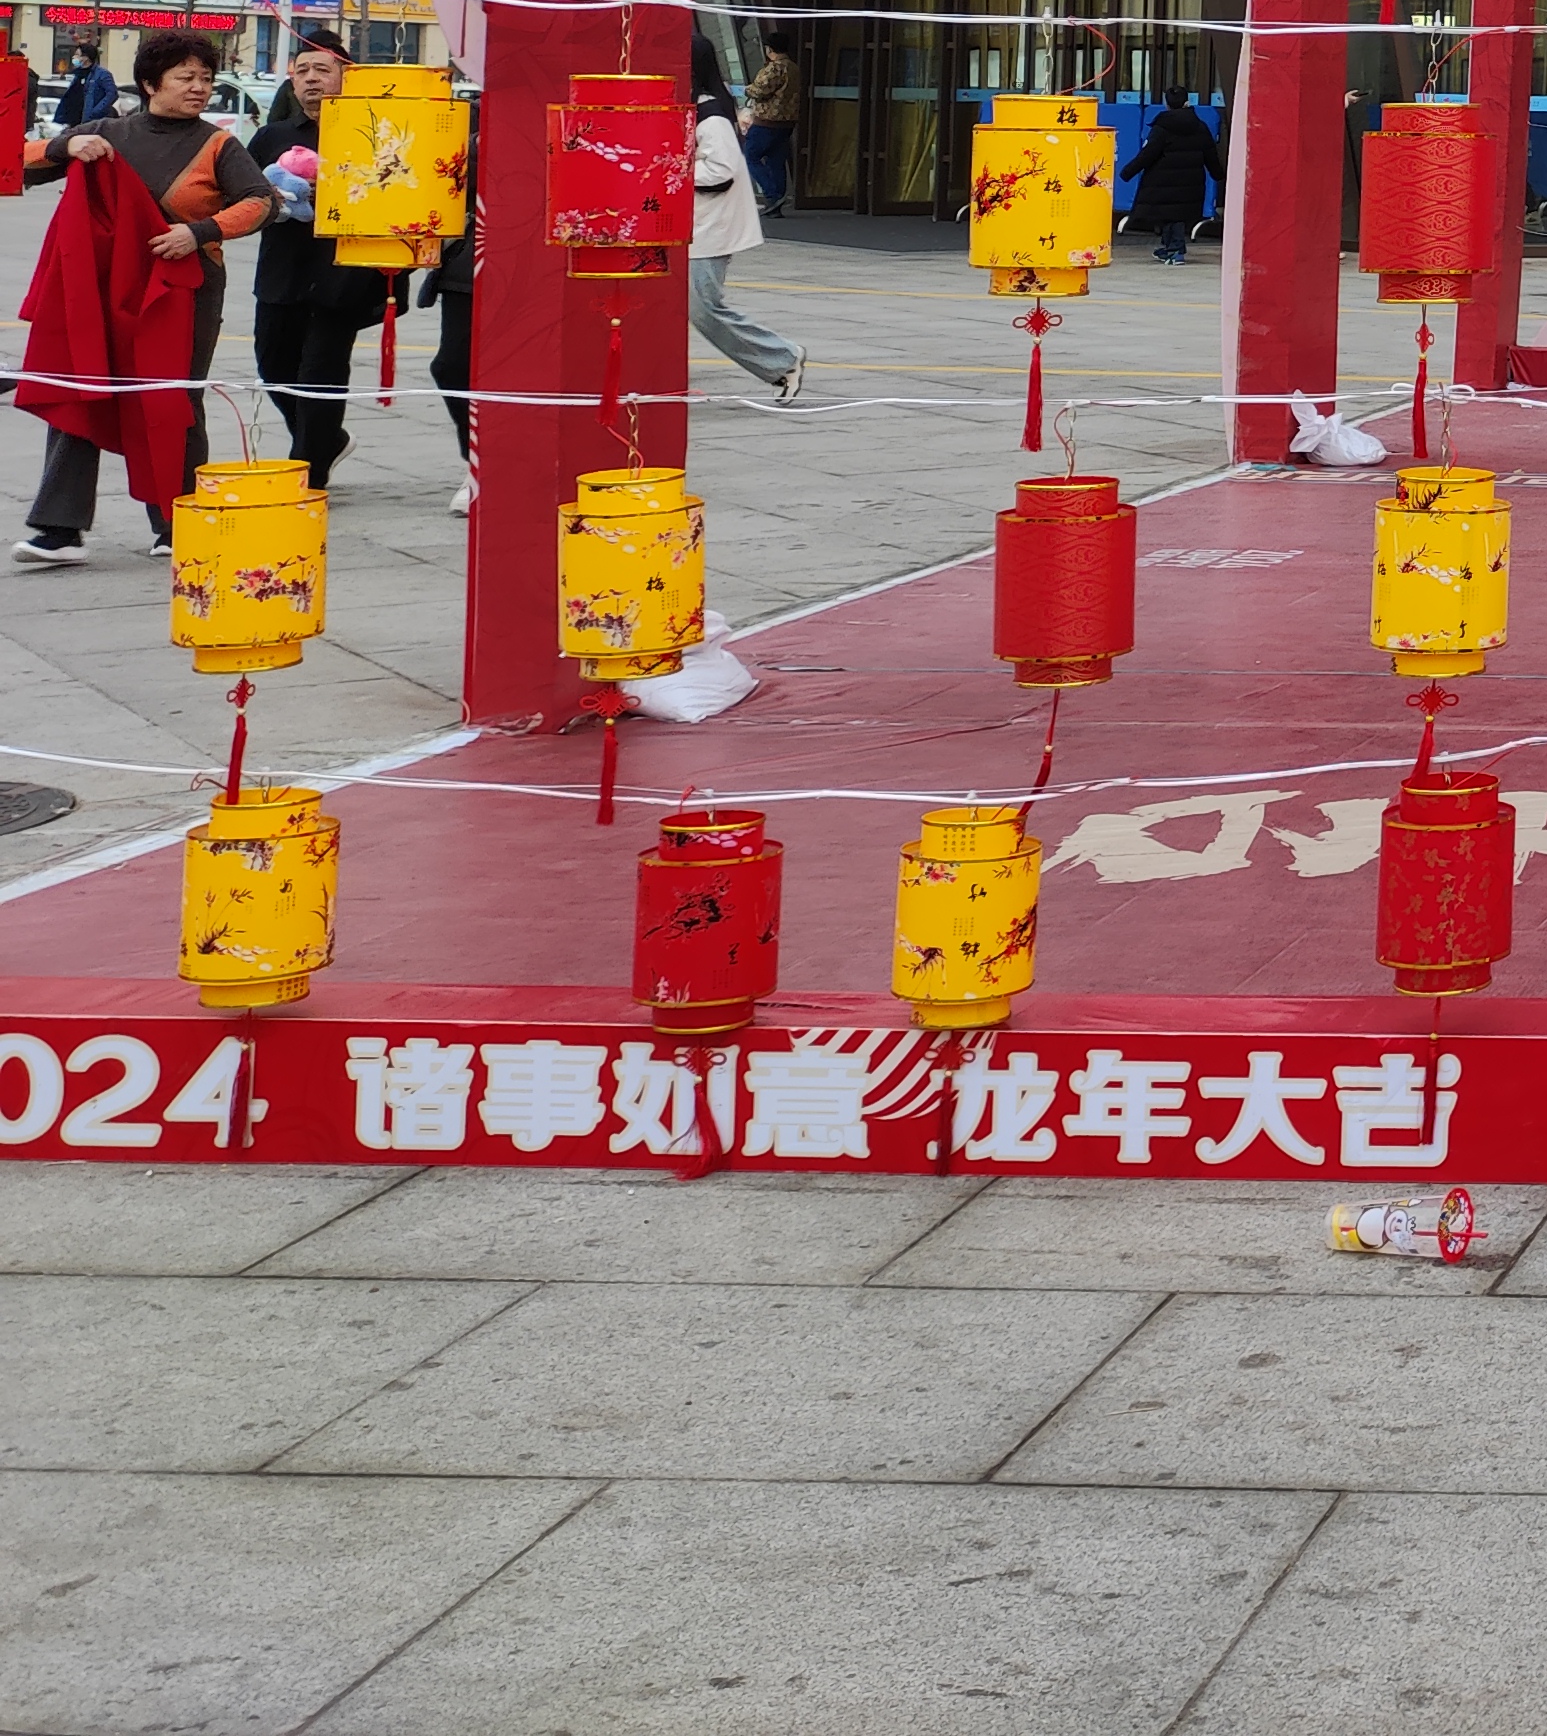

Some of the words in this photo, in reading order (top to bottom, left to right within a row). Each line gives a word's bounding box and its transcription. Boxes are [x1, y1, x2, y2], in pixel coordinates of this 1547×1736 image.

[1057, 104, 1077, 125] 梅
[1044, 175, 1061, 194] 梅
[327, 202, 341, 222] 梅
[641, 192, 661, 212] 梅
[1039, 232, 1057, 249] 竹
[646, 575, 665, 592] 梅
[0, 1031, 268, 1149] 024
[344, 1035, 873, 1160] 诸事如意
[926, 1046, 1462, 1169] 龙年大吉
